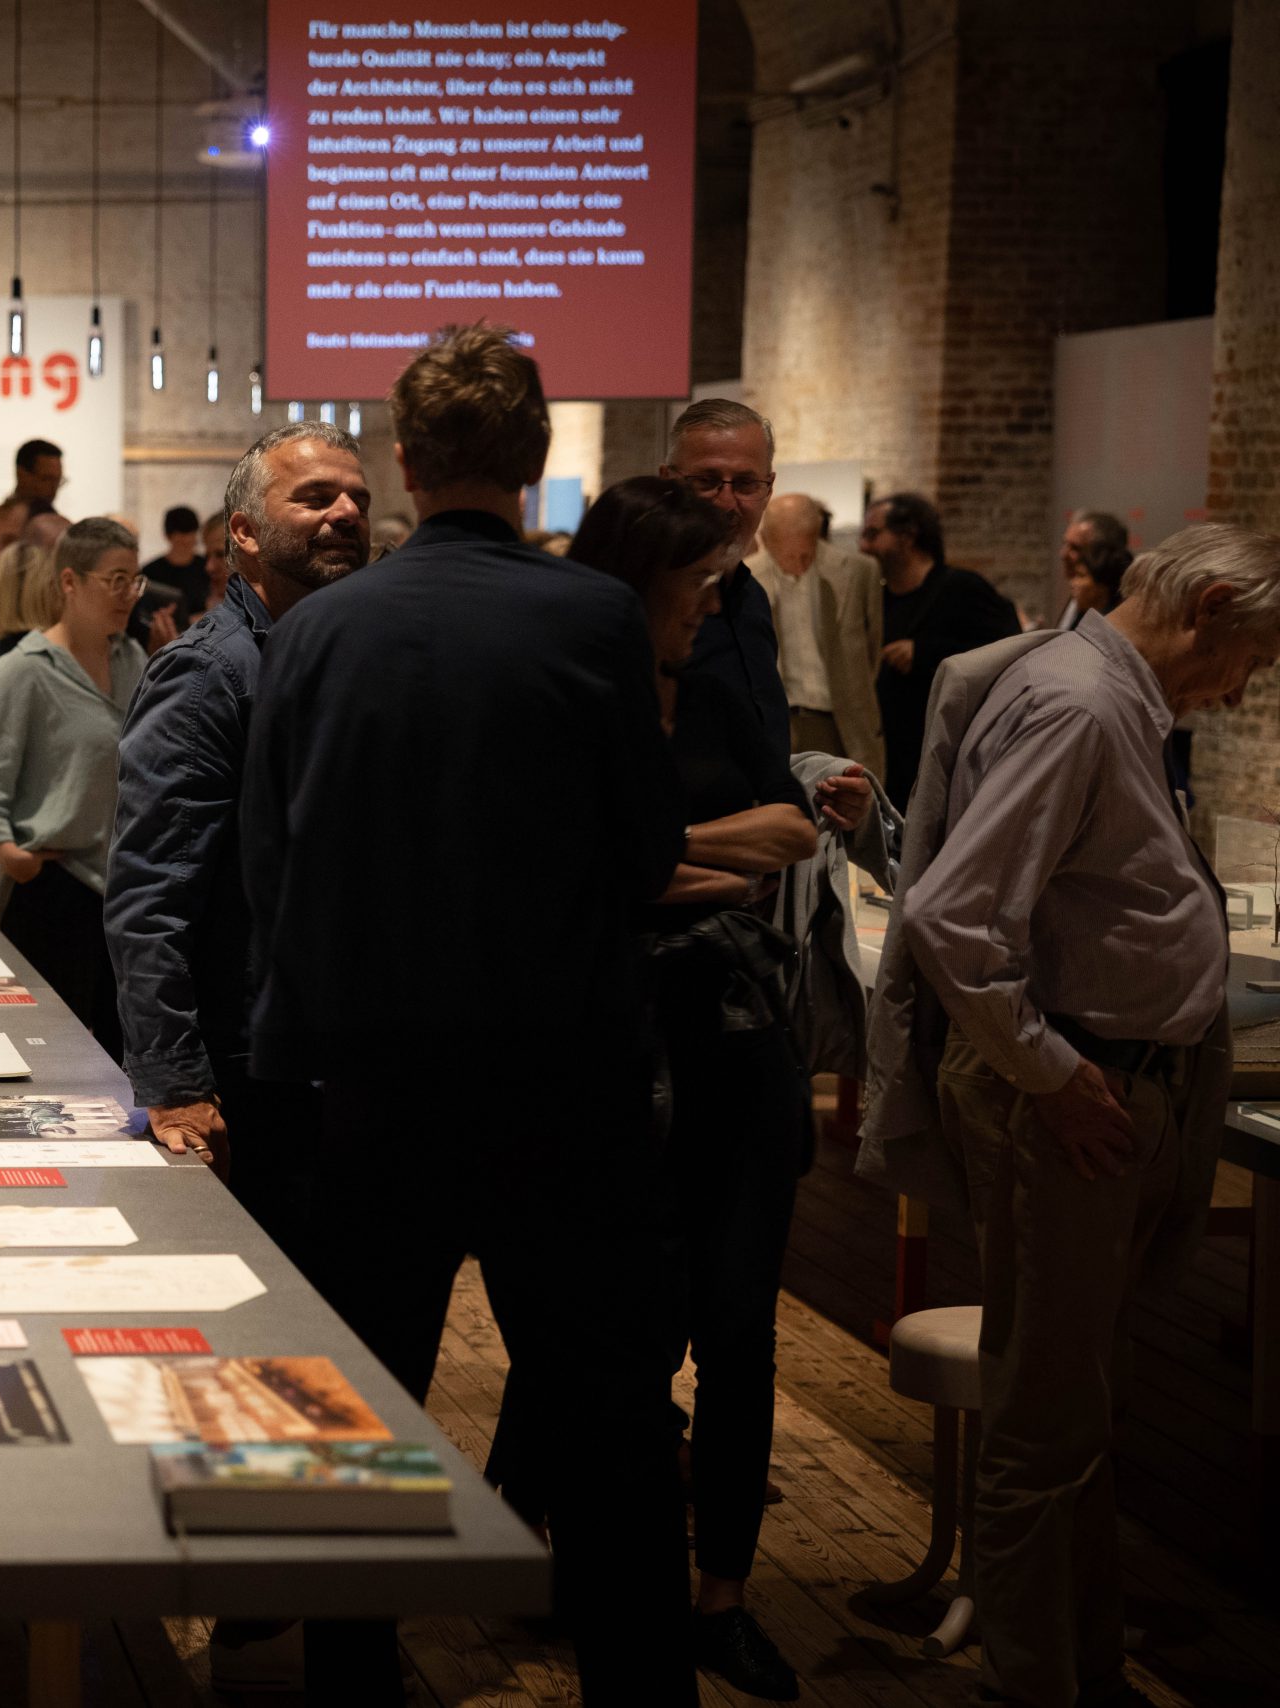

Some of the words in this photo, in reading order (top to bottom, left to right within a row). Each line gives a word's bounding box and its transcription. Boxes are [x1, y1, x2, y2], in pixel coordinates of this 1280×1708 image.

[309, 19, 340, 39] Für
[341, 20, 412, 39] manche
[413, 19, 504, 38] Menschen
[505, 20, 530, 38] ist
[531, 21, 571, 38] eine
[362, 48, 433, 68] Qualität
[434, 48, 464, 67] nie
[514, 49, 544, 67] ein
[545, 48, 605, 70] Aspekt
[307, 77, 339, 96] der
[340, 77, 444, 97] Architektur,
[445, 77, 487, 96] über
[488, 77, 523, 96] den
[524, 80, 547, 95] es
[548, 77, 587, 95] sich
[588, 77, 633, 95] nicht
[307, 109, 330, 125] zu
[331, 105, 384, 125] reden
[438, 105, 472, 124] Wir
[473, 105, 528, 124] haben
[529, 107, 580, 124] einen
[581, 105, 620, 123] sehr
[308, 134, 391, 154] intuitiven
[392, 134, 458, 156] Zugang
[459, 137, 481, 153] zu
[482, 137, 551, 153] unserer
[552, 134, 608, 152] Arbeit
[609, 134, 643, 152] und
[307, 163, 389, 185] beginnen
[390, 162, 418, 181] oft
[419, 163, 450, 182] mit
[451, 163, 499, 181] einer
[500, 162, 579, 181] formalen
[580, 162, 648, 180] Antwort
[307, 191, 337, 210] auf
[338, 191, 388, 210] einen
[426, 191, 467, 210] eine
[468, 190, 539, 209] Position
[540, 190, 582, 209] oder
[583, 192, 622, 209] eine
[307, 219, 385, 239] Funktion
[394, 219, 437, 238] auch
[438, 222, 486, 238] wenn
[487, 222, 548, 238] unsere
[549, 218, 625, 237] Gebäude
[307, 248, 386, 267] meistens
[387, 251, 410, 266] so
[411, 247, 477, 266] einfach
[524, 247, 566, 265] dass
[567, 248, 595, 265] sie
[596, 247, 644, 265] kaum
[307, 280, 353, 299] mehr
[354, 279, 382, 299] als
[383, 279, 423, 298] eine
[424, 279, 502, 298] Funktion
